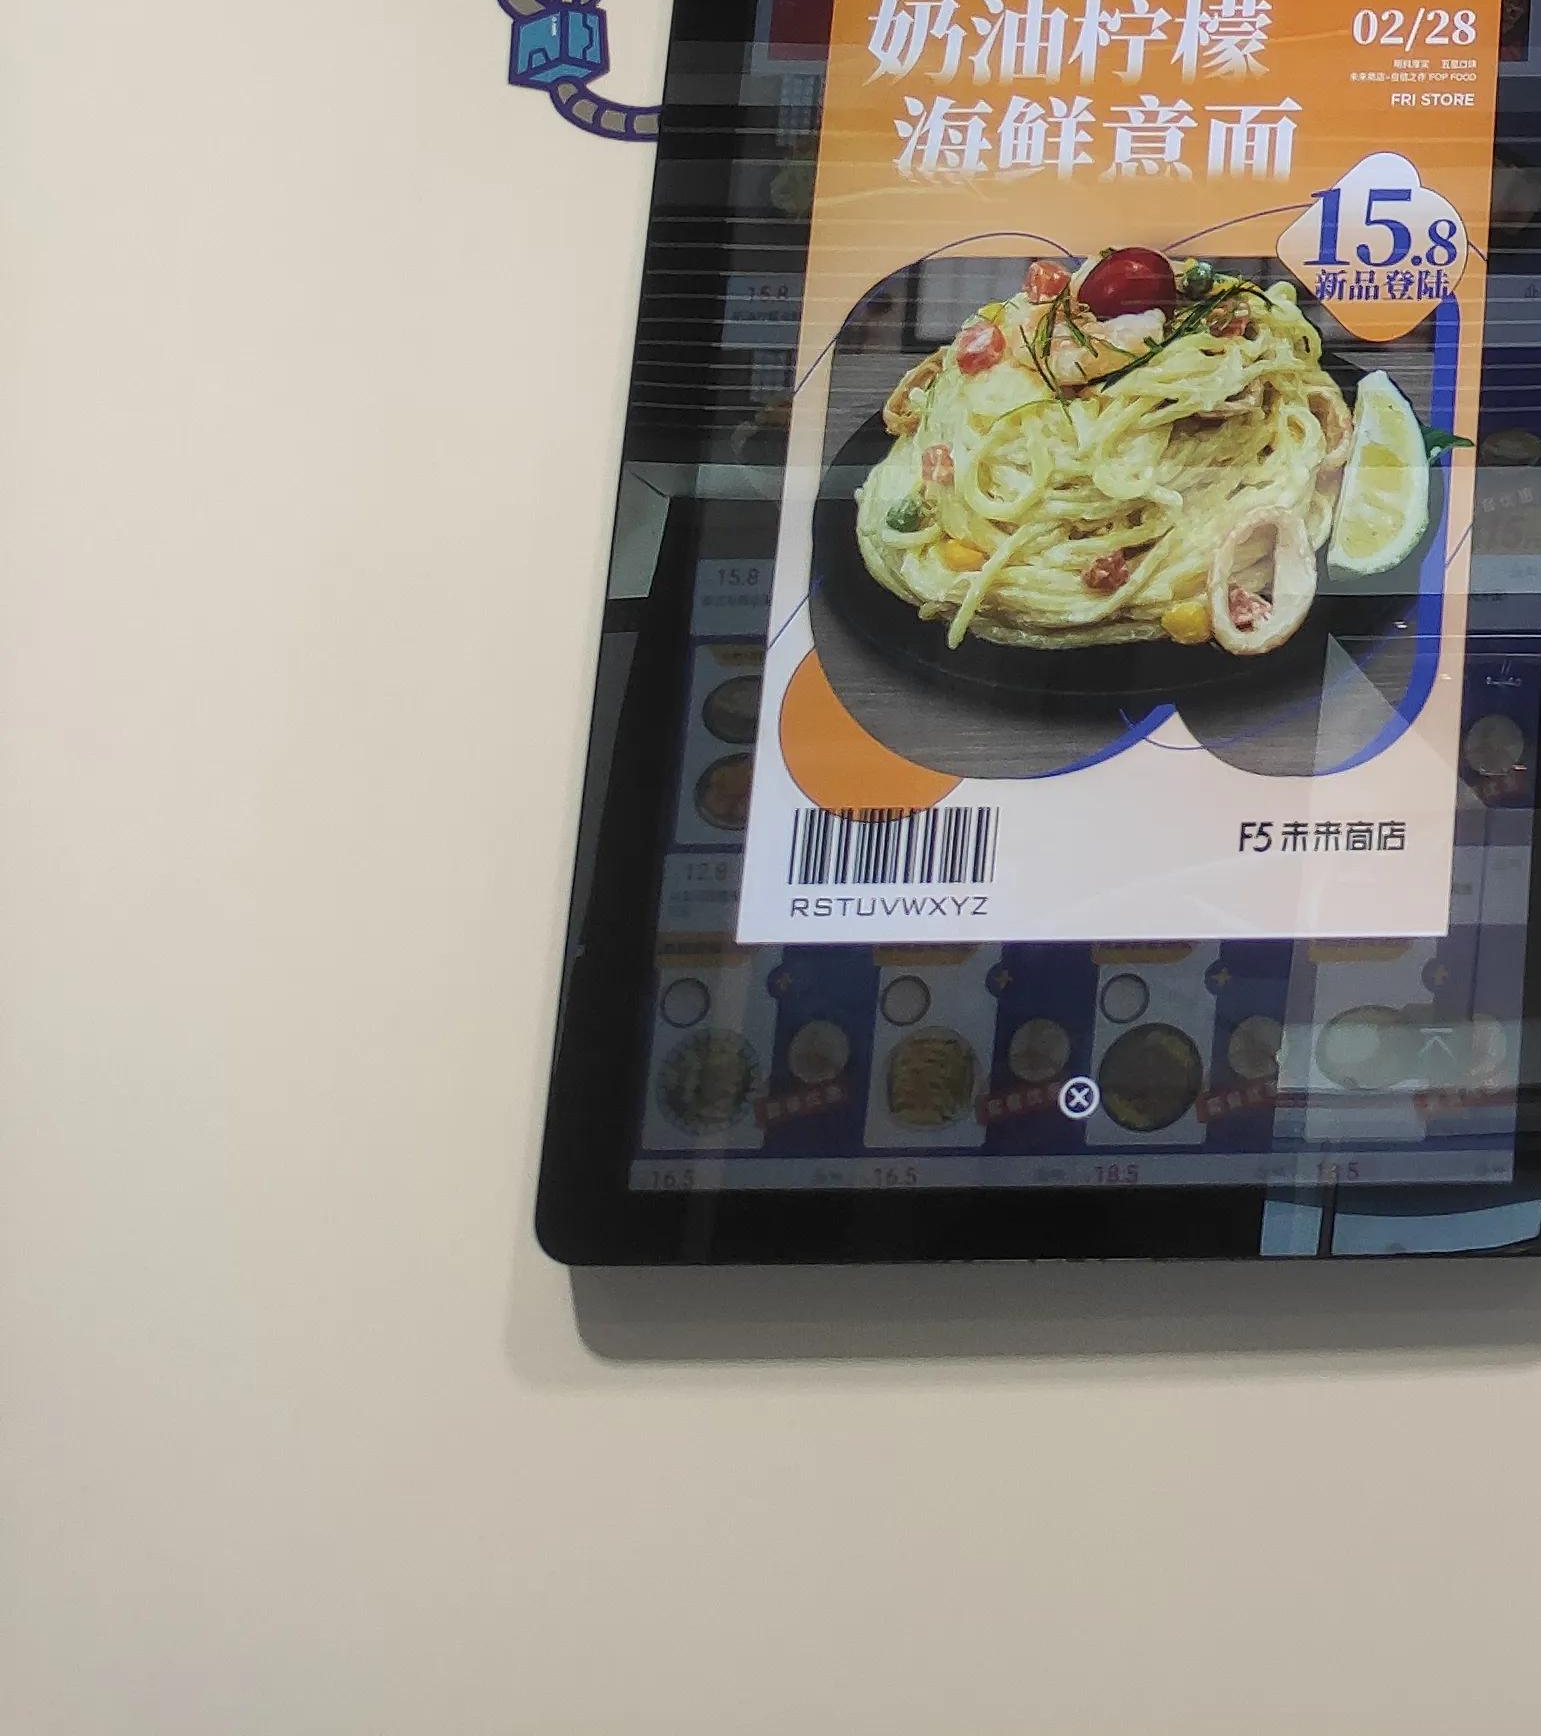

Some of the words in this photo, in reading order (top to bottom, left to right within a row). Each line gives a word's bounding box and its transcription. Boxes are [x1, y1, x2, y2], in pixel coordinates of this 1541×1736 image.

[1352, 7, 1476, 51] 02/28
[1391, 93, 1416, 106] FRI
[1421, 93, 1475, 106] STORE
[892, 93, 1302, 182] 海鲜意面
[1304, 188, 1458, 267] 15.8
[1315, 269, 1455, 301] 新品登陆
[1238, 820, 1274, 853] F5
[1281, 820, 1407, 853] 未来商店
[790, 896, 990, 918] RSTUVWXYZ
